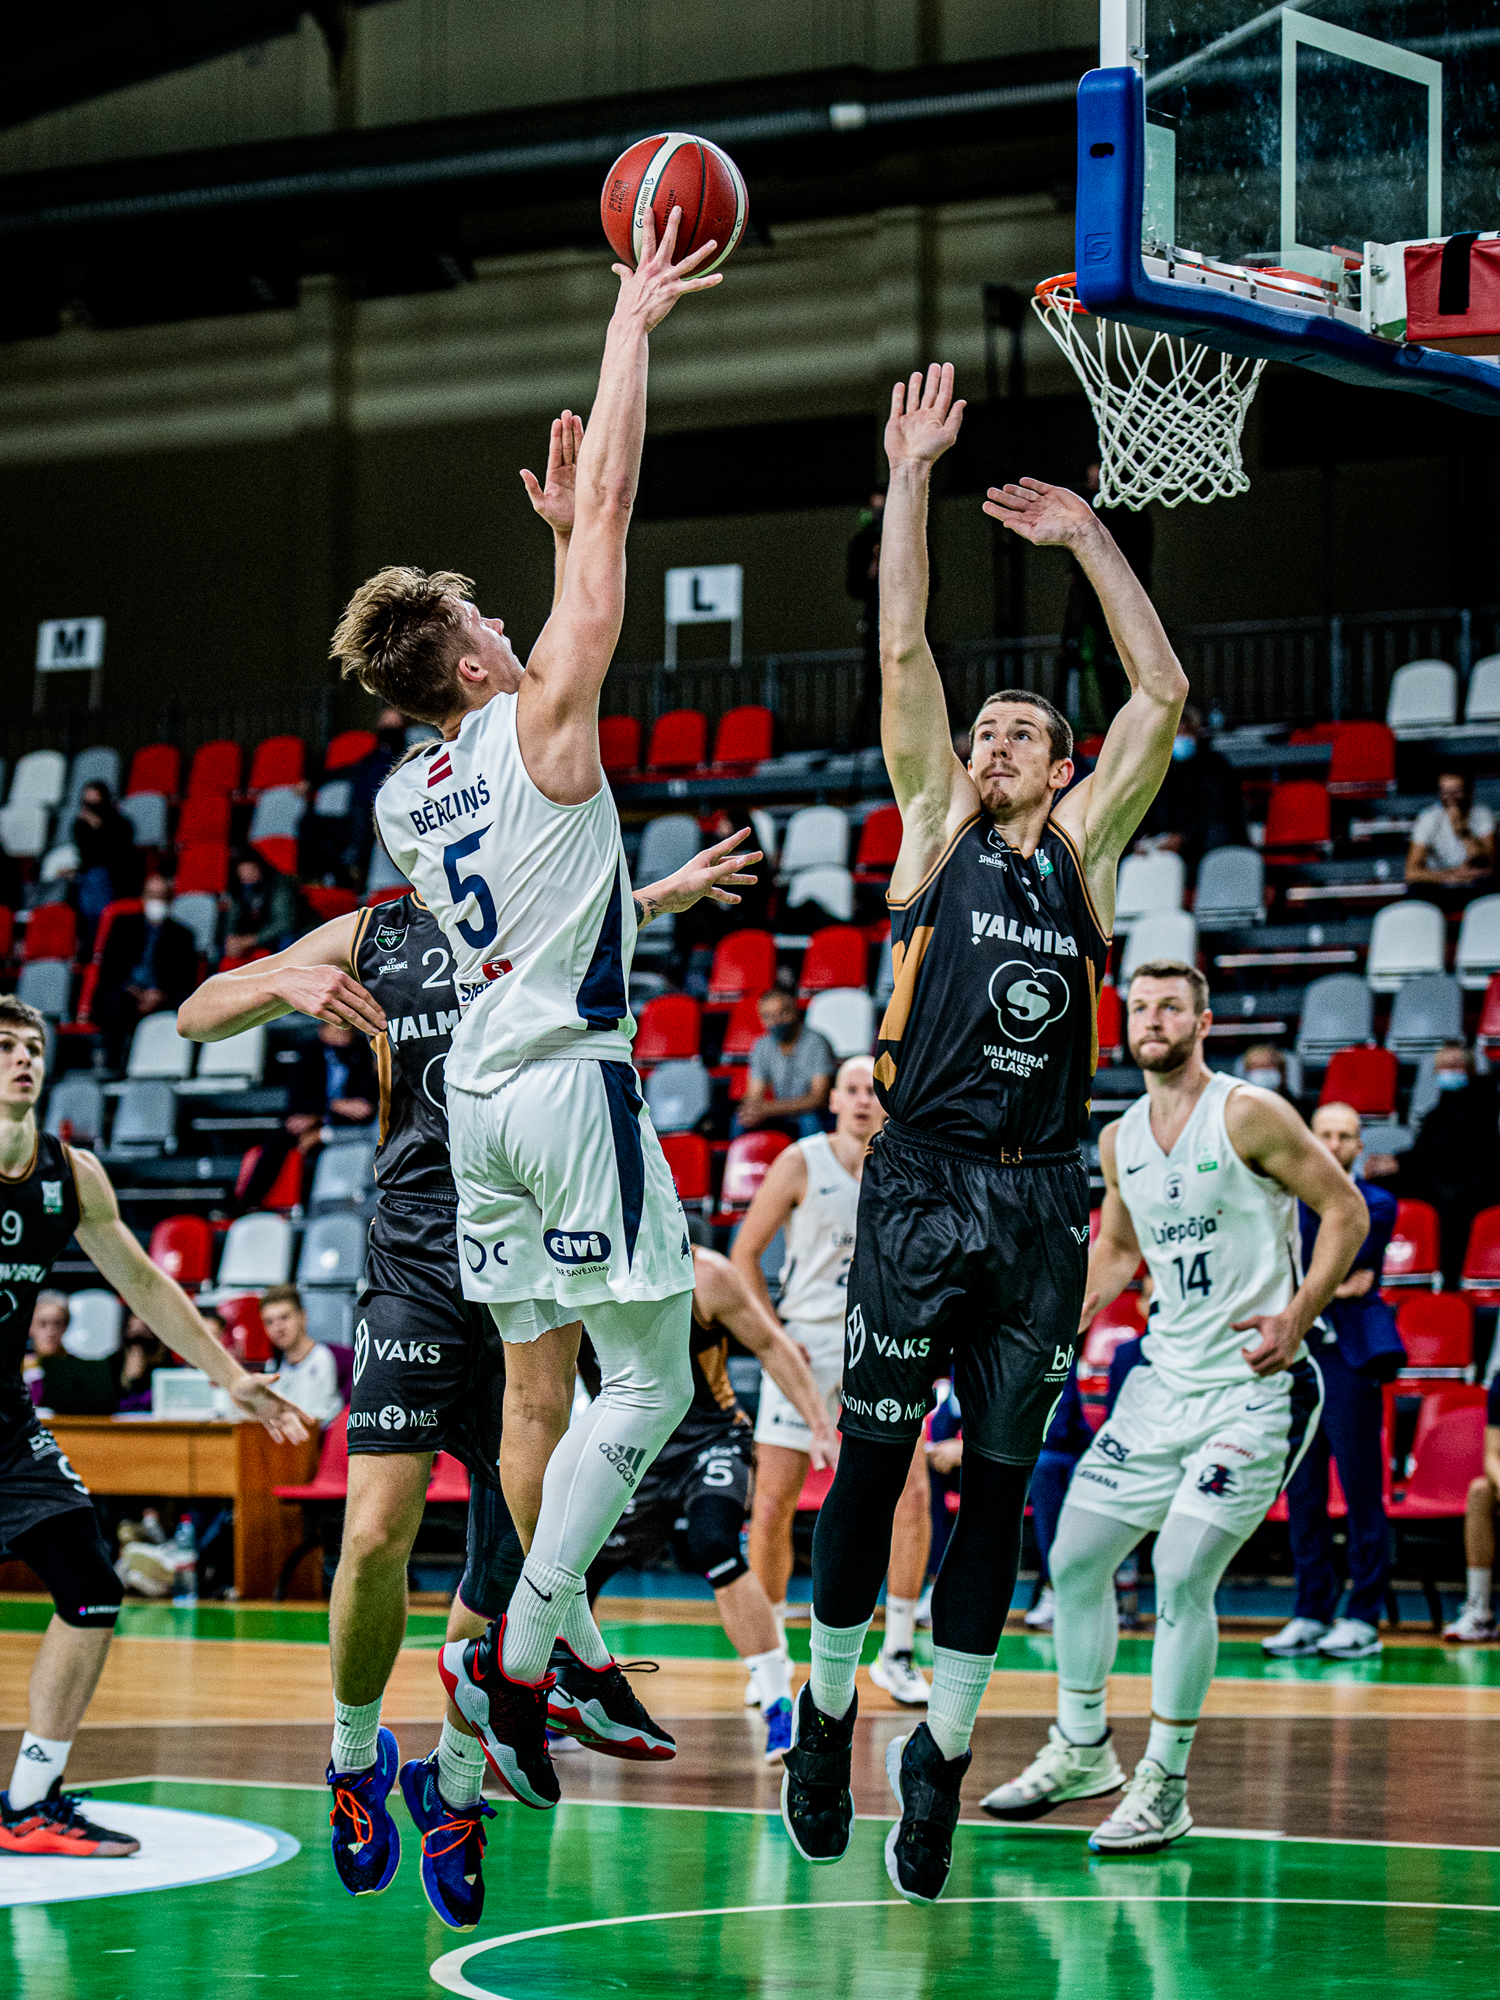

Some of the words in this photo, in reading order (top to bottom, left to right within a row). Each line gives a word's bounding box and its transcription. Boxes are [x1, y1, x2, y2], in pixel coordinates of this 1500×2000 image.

[691, 576, 715, 612] L
[53, 628, 87, 658] M
[443, 821, 498, 950] 5
[378, 960, 408, 975] SPALDING
[991, 1057, 1032, 1078] GLASS
[1172, 1251, 1213, 1300] 14
[373, 1338, 441, 1365] VAKS
[873, 1332, 931, 1360] VAKS
[598, 1442, 636, 1488] adidas
[702, 1459, 734, 1487] 5
